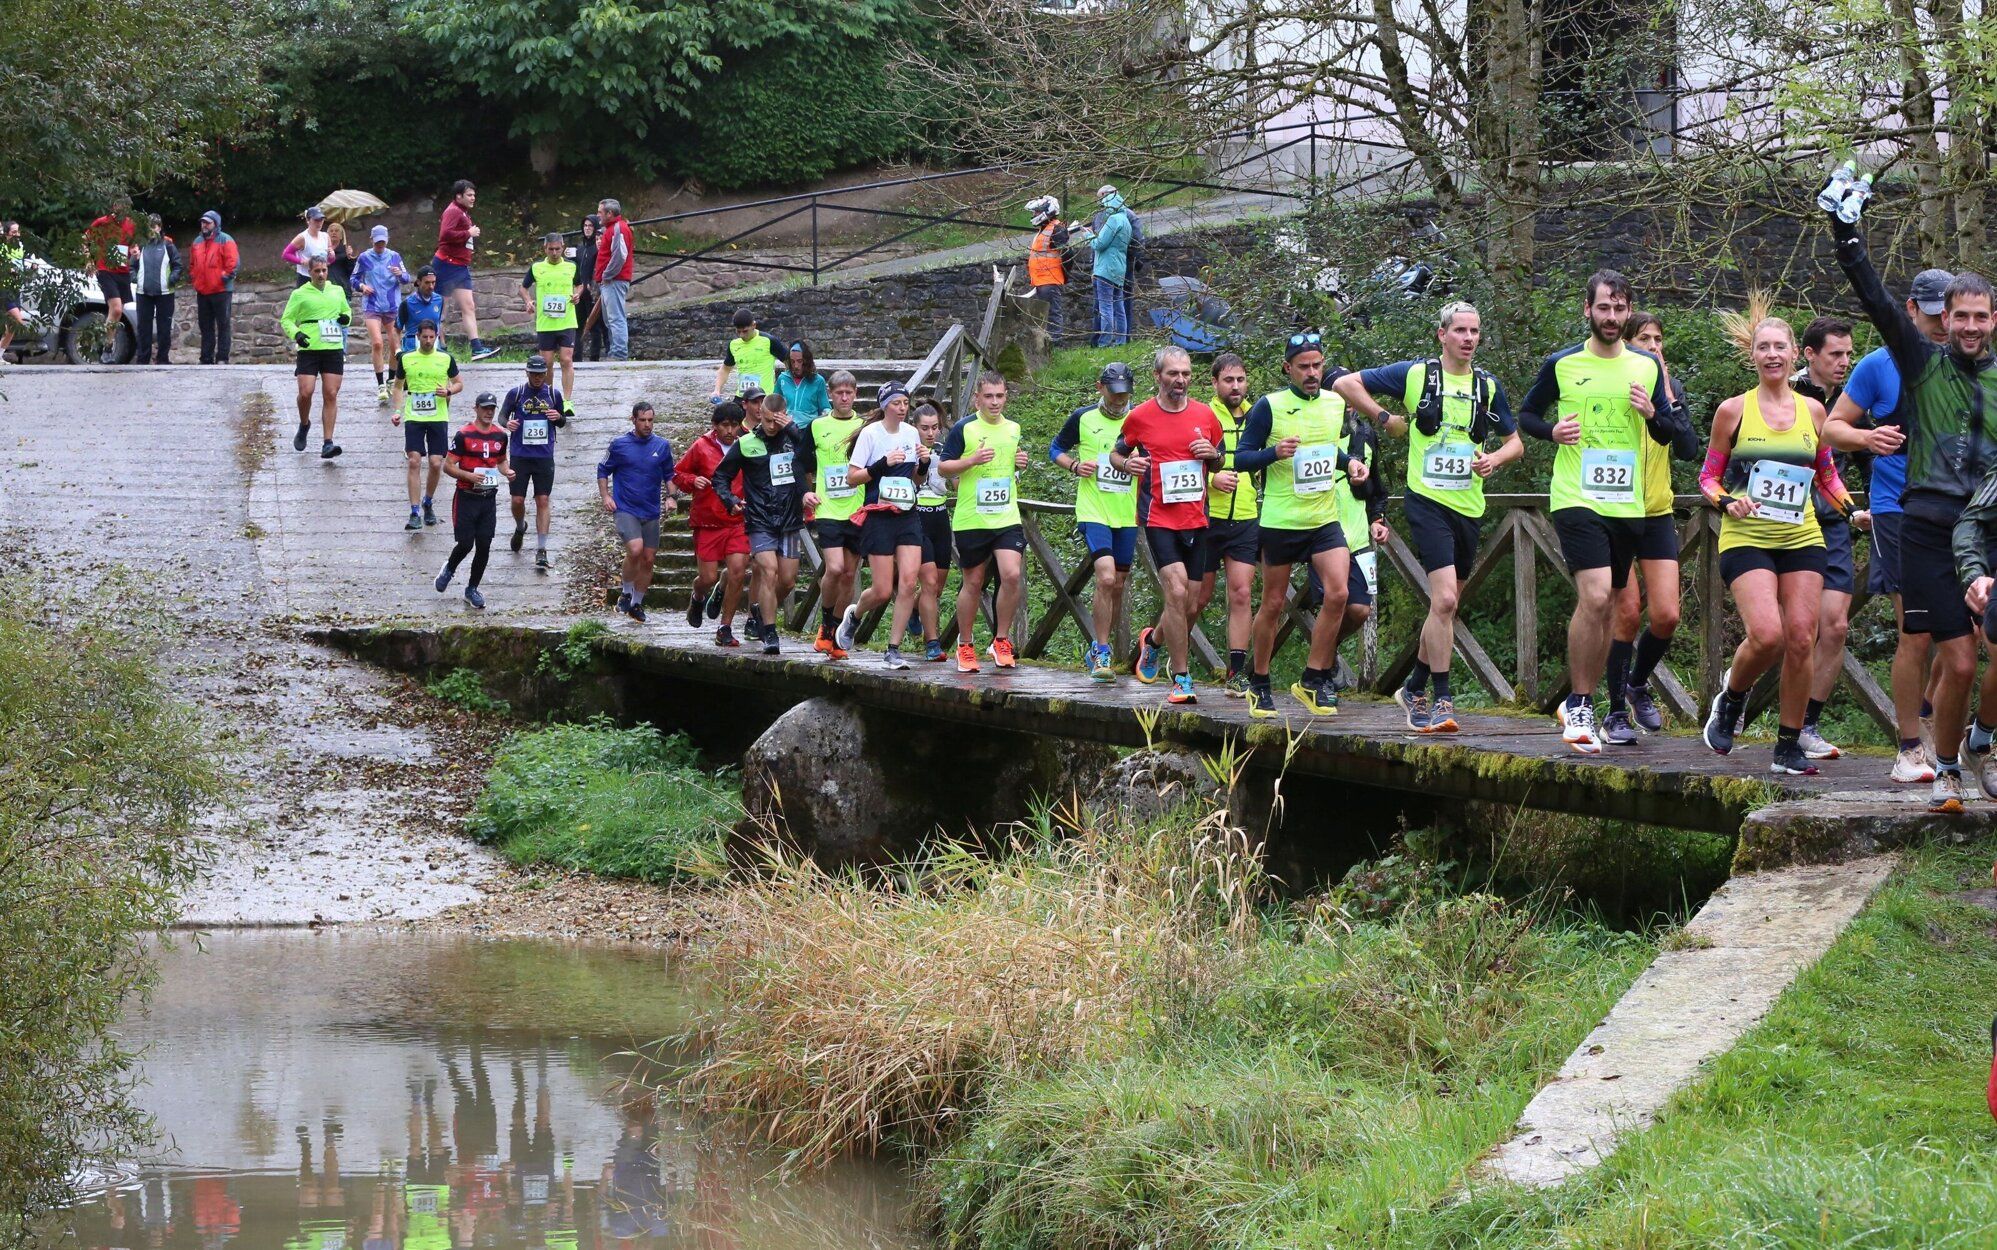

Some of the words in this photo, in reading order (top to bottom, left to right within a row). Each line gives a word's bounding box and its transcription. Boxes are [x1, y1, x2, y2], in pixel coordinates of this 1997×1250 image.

[547, 302, 563, 310] 578
[416, 400, 432, 408] 584
[527, 428, 544, 437] 236
[483, 442, 490, 459] 9
[777, 463, 793, 475] 53
[1304, 460, 1332, 477] 202
[1434, 457, 1465, 474] 543
[1171, 474, 1197, 489] 753
[1593, 467, 1627, 485] 832
[887, 487, 908, 499] 773
[985, 489, 1006, 502] 256
[1761, 480, 1795, 502] 341
